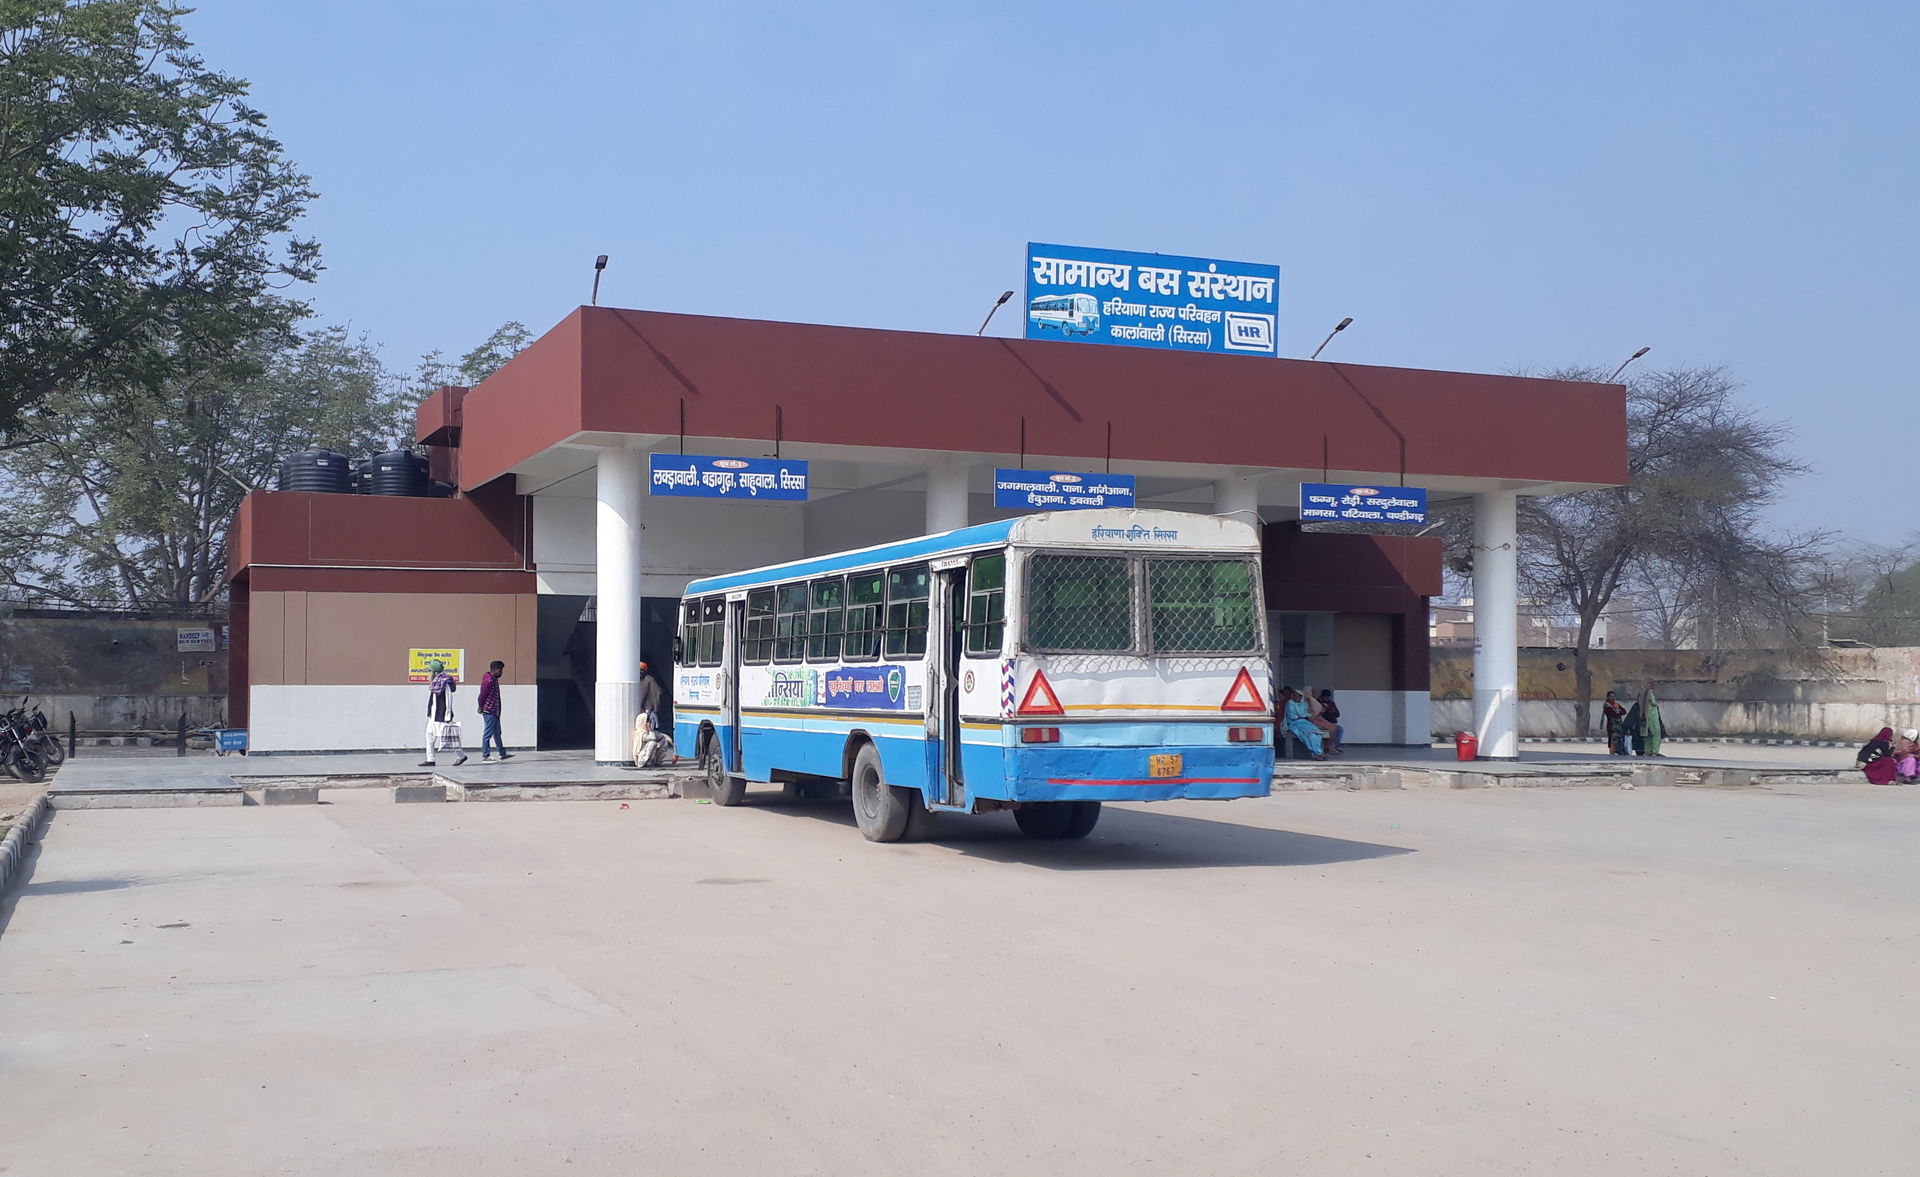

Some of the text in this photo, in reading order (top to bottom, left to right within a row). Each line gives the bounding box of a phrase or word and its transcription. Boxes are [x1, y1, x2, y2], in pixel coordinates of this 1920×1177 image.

[1032, 256, 1275, 303] सामान्य बस संस्थान
[1102, 297, 1222, 324] हरियाणा राज्य परिवहन
[1110, 322, 1212, 350] कालांवाली (सिरसा)
[1237, 325, 1261, 338] HR
[1091, 525, 1124, 541] हरियाणा
